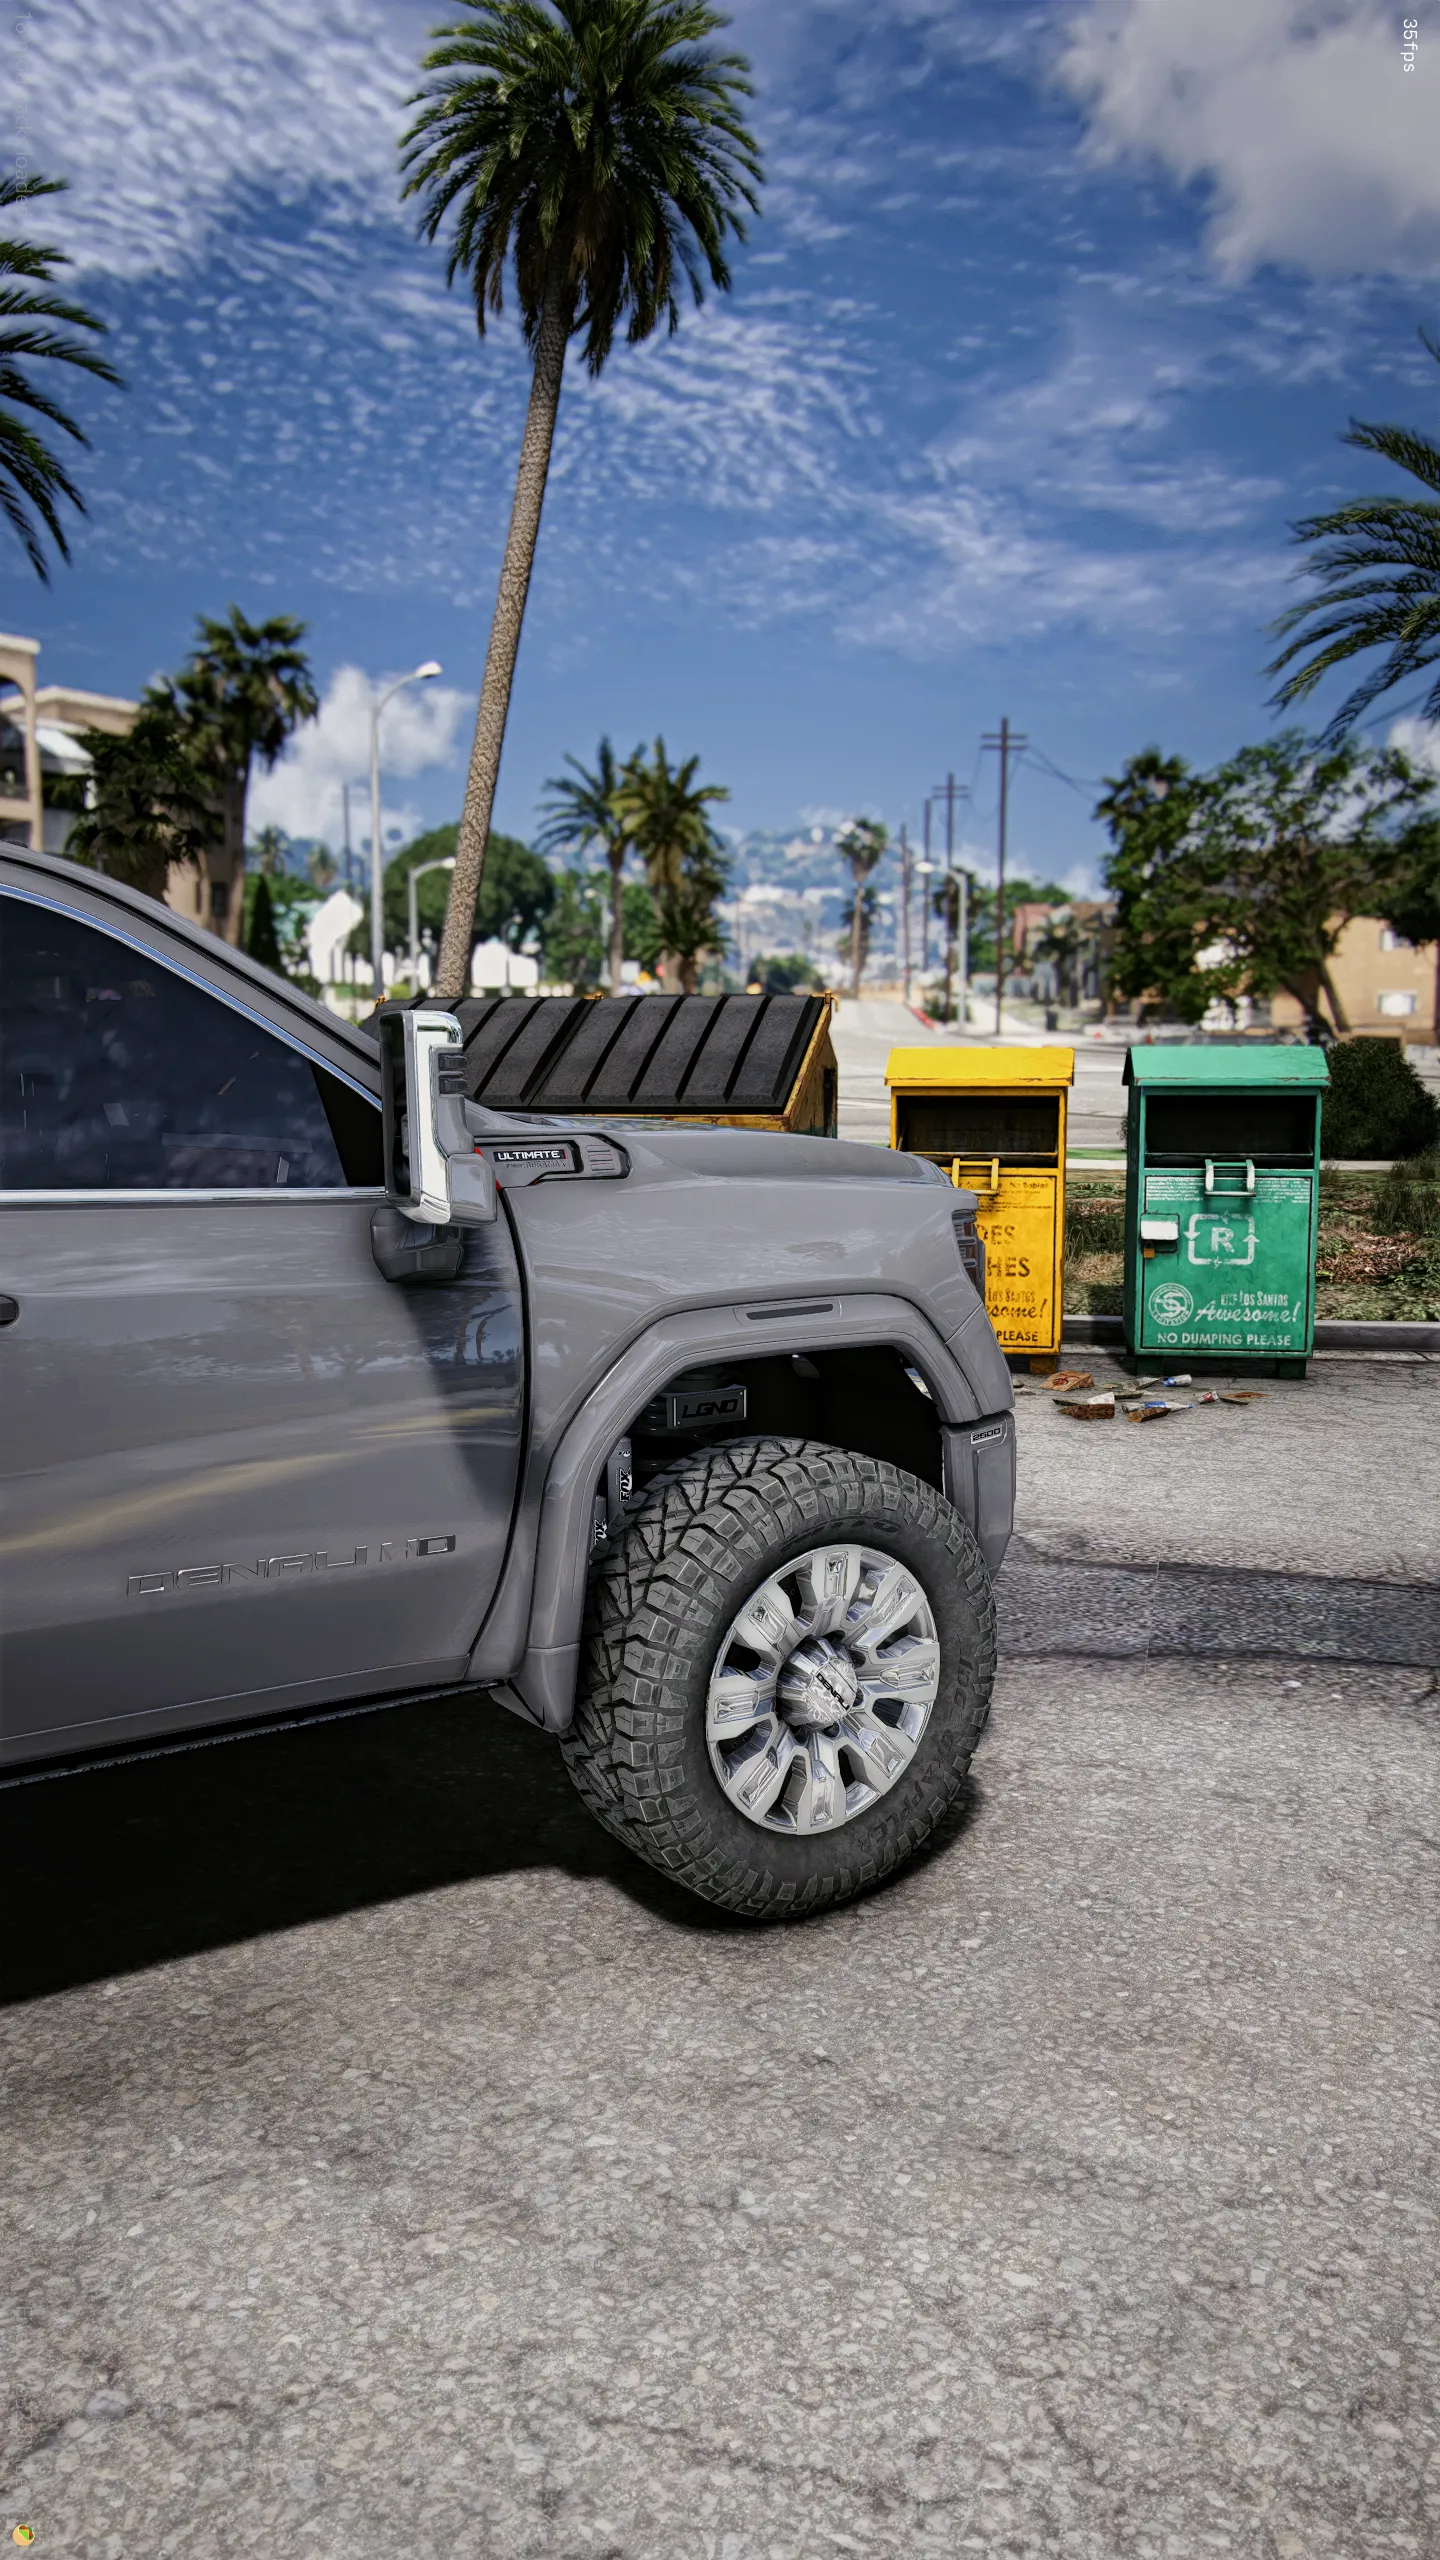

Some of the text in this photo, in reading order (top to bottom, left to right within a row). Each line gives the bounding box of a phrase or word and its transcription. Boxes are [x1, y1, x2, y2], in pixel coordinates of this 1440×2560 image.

[498, 1150, 561, 1161] ULTIMATE
[1211, 1227, 1235, 1253] R
[1194, 1300, 1302, 1324] Awesome!
[996, 1329, 1039, 1343] PLEASE
[1157, 1332, 1292, 1347] NO DUMPING PLEASE
[972, 1427, 1001, 1442] 2500
[619, 1466, 632, 1503] FOX
[126, 1545, 368, 1597] DENALI
